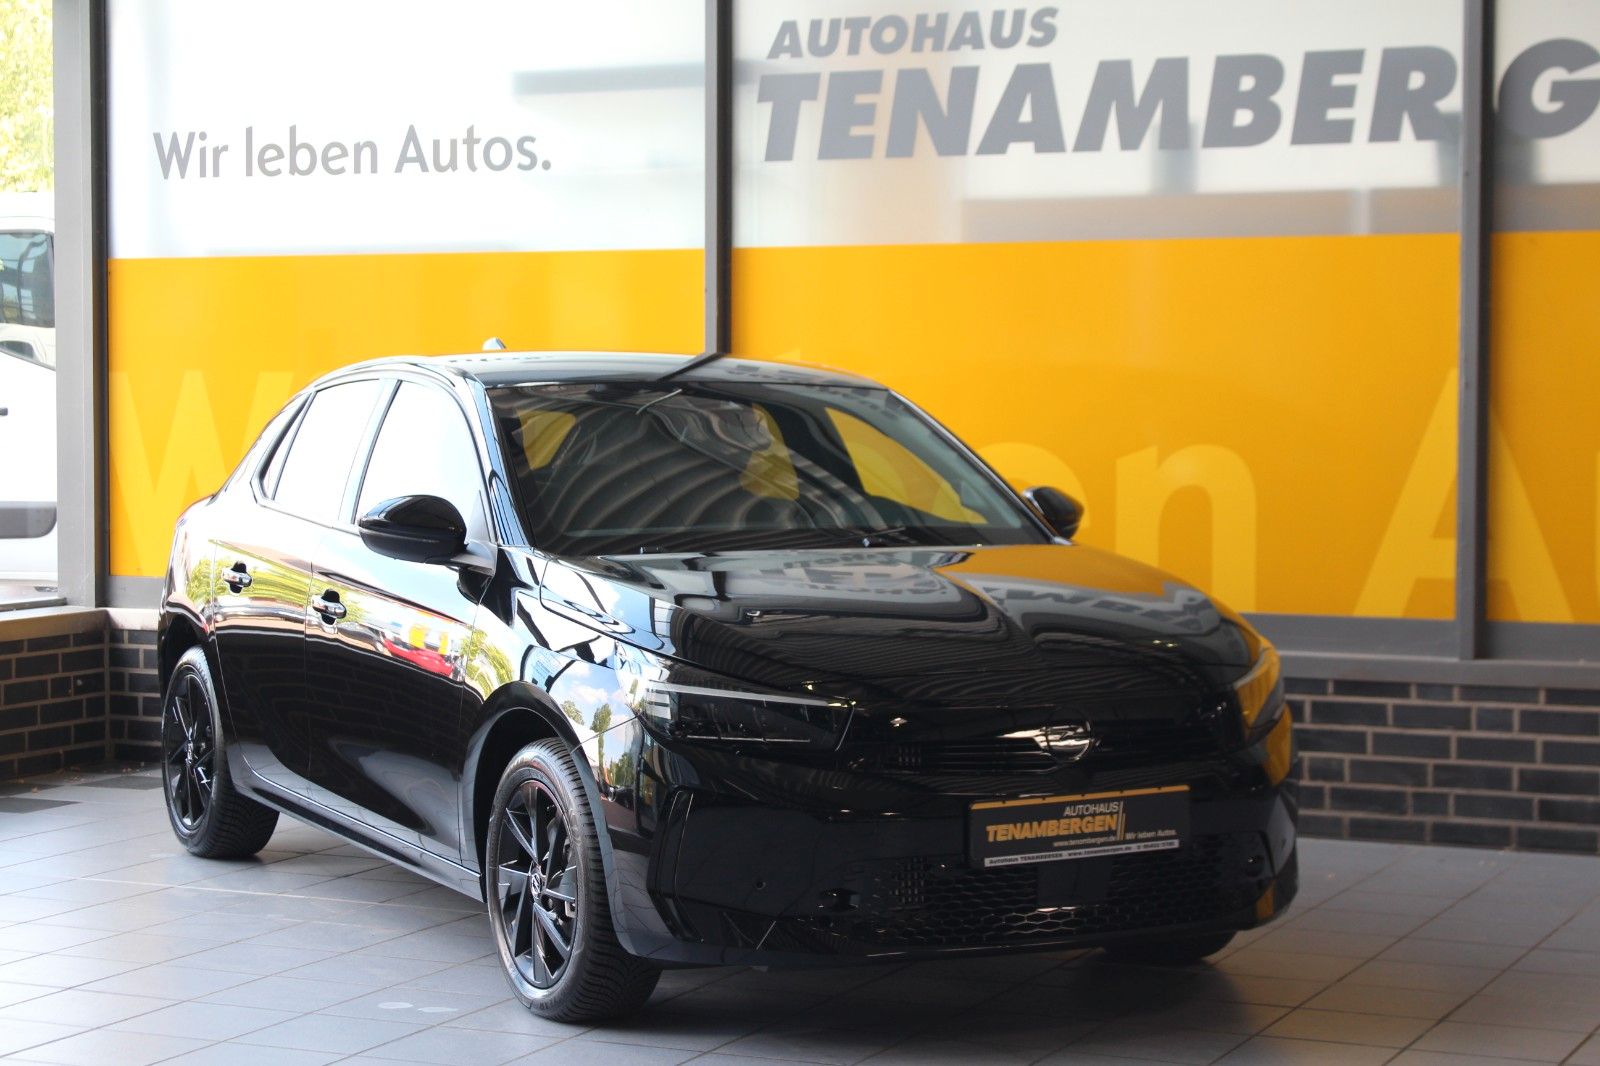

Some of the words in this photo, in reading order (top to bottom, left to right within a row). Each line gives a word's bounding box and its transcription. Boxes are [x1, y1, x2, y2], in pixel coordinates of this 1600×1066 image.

[766, 6, 1059, 60] AUTOHAUS
[152, 130, 229, 180] Wir
[245, 124, 378, 177] leben
[394, 124, 552, 173] Autos.
[986, 813, 1119, 843] TENAMBERGEN
[1063, 801, 1120, 817] AUTOHAUS
